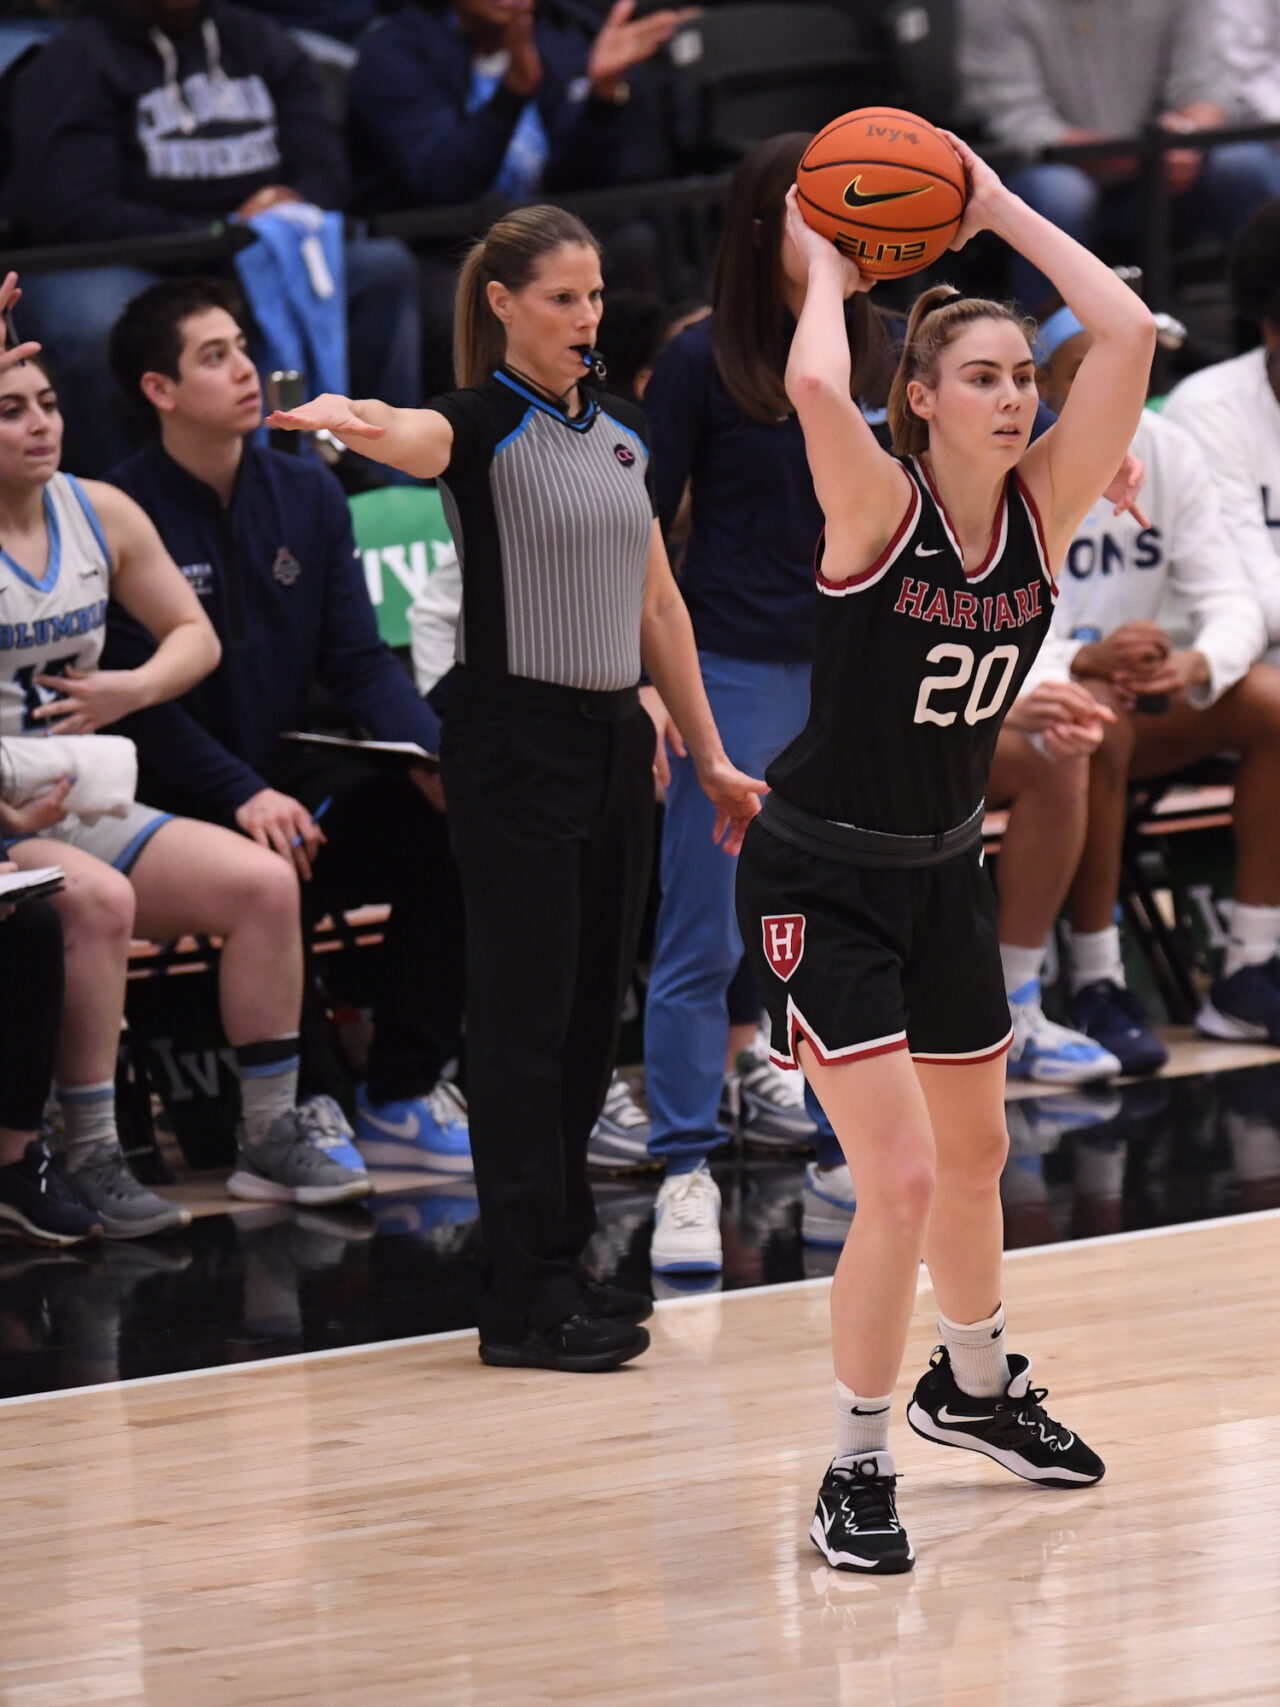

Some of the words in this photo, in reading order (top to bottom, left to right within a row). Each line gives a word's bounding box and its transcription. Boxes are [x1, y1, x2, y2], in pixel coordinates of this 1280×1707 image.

[865, 122, 902, 142] Ivy
[833, 229, 926, 262] ELITE
[914, 643, 1020, 727] 20
[769, 922, 795, 962] H
